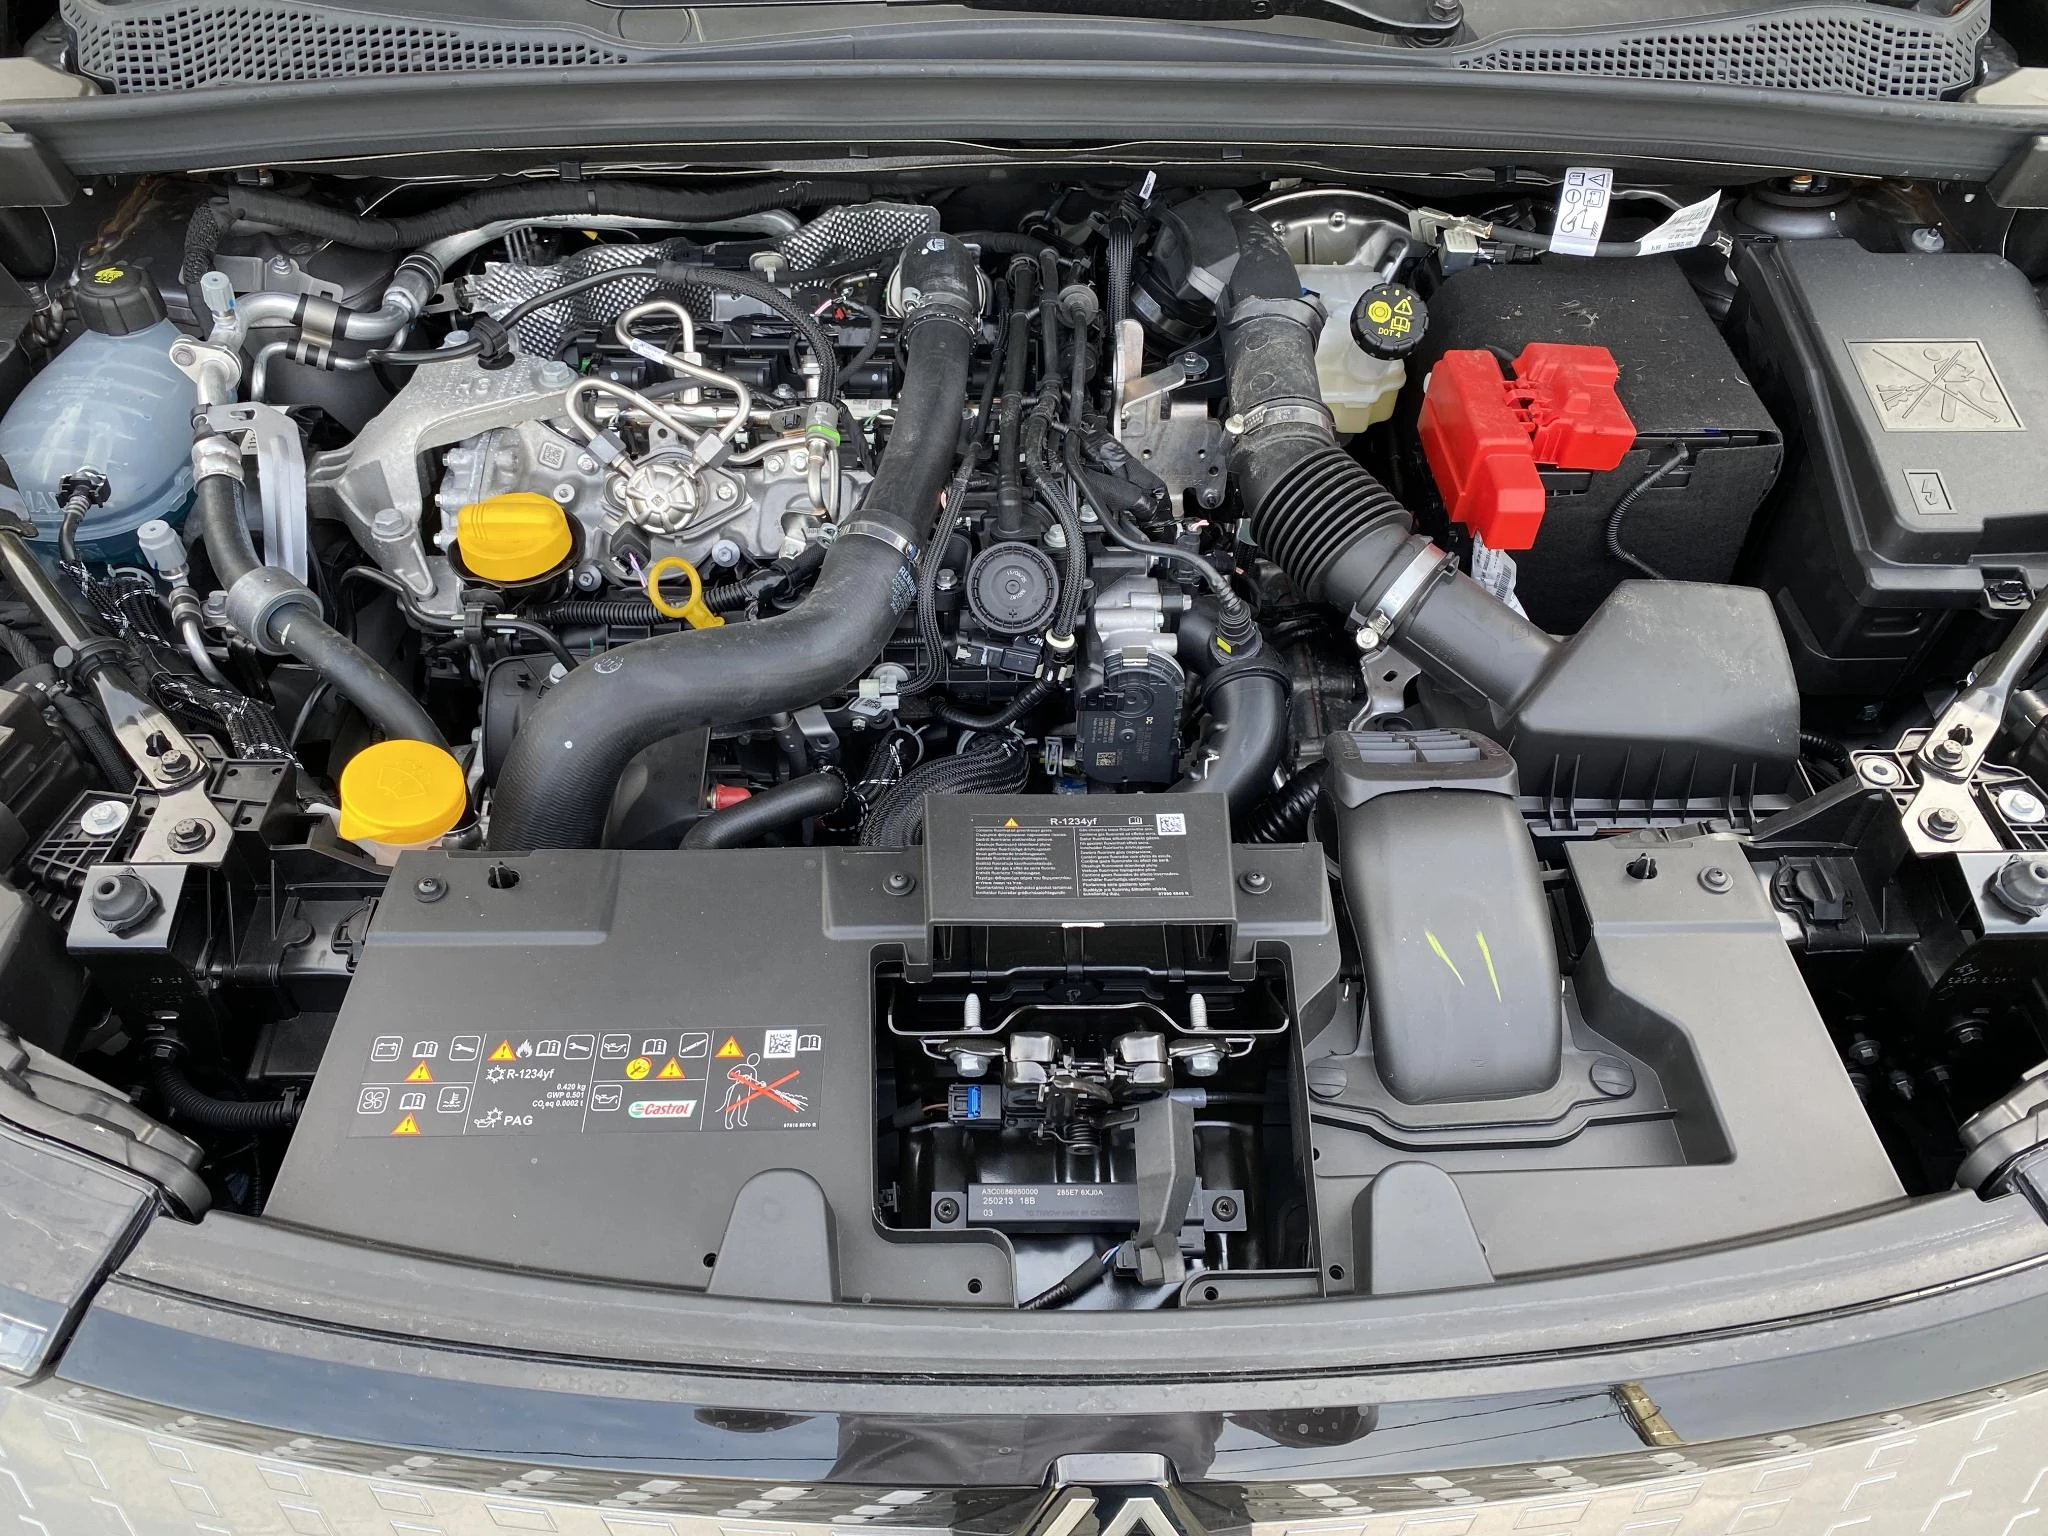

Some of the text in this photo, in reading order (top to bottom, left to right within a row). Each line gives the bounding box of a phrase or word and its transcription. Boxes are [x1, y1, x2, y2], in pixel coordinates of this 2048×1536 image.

[1378, 327, 1395, 336] DOT
[1050, 817, 1097, 827] R-1234yf
[506, 1068, 555, 1081] R-1234yf
[577, 1083, 587, 1091] kg
[547, 1091, 584, 1099] GWP 0.501
[644, 1101, 691, 1115] Castrol
[503, 1115, 533, 1126] PAG
[983, 1197, 1036, 1205] 250213 18B
[983, 1208, 993, 1217] 03
